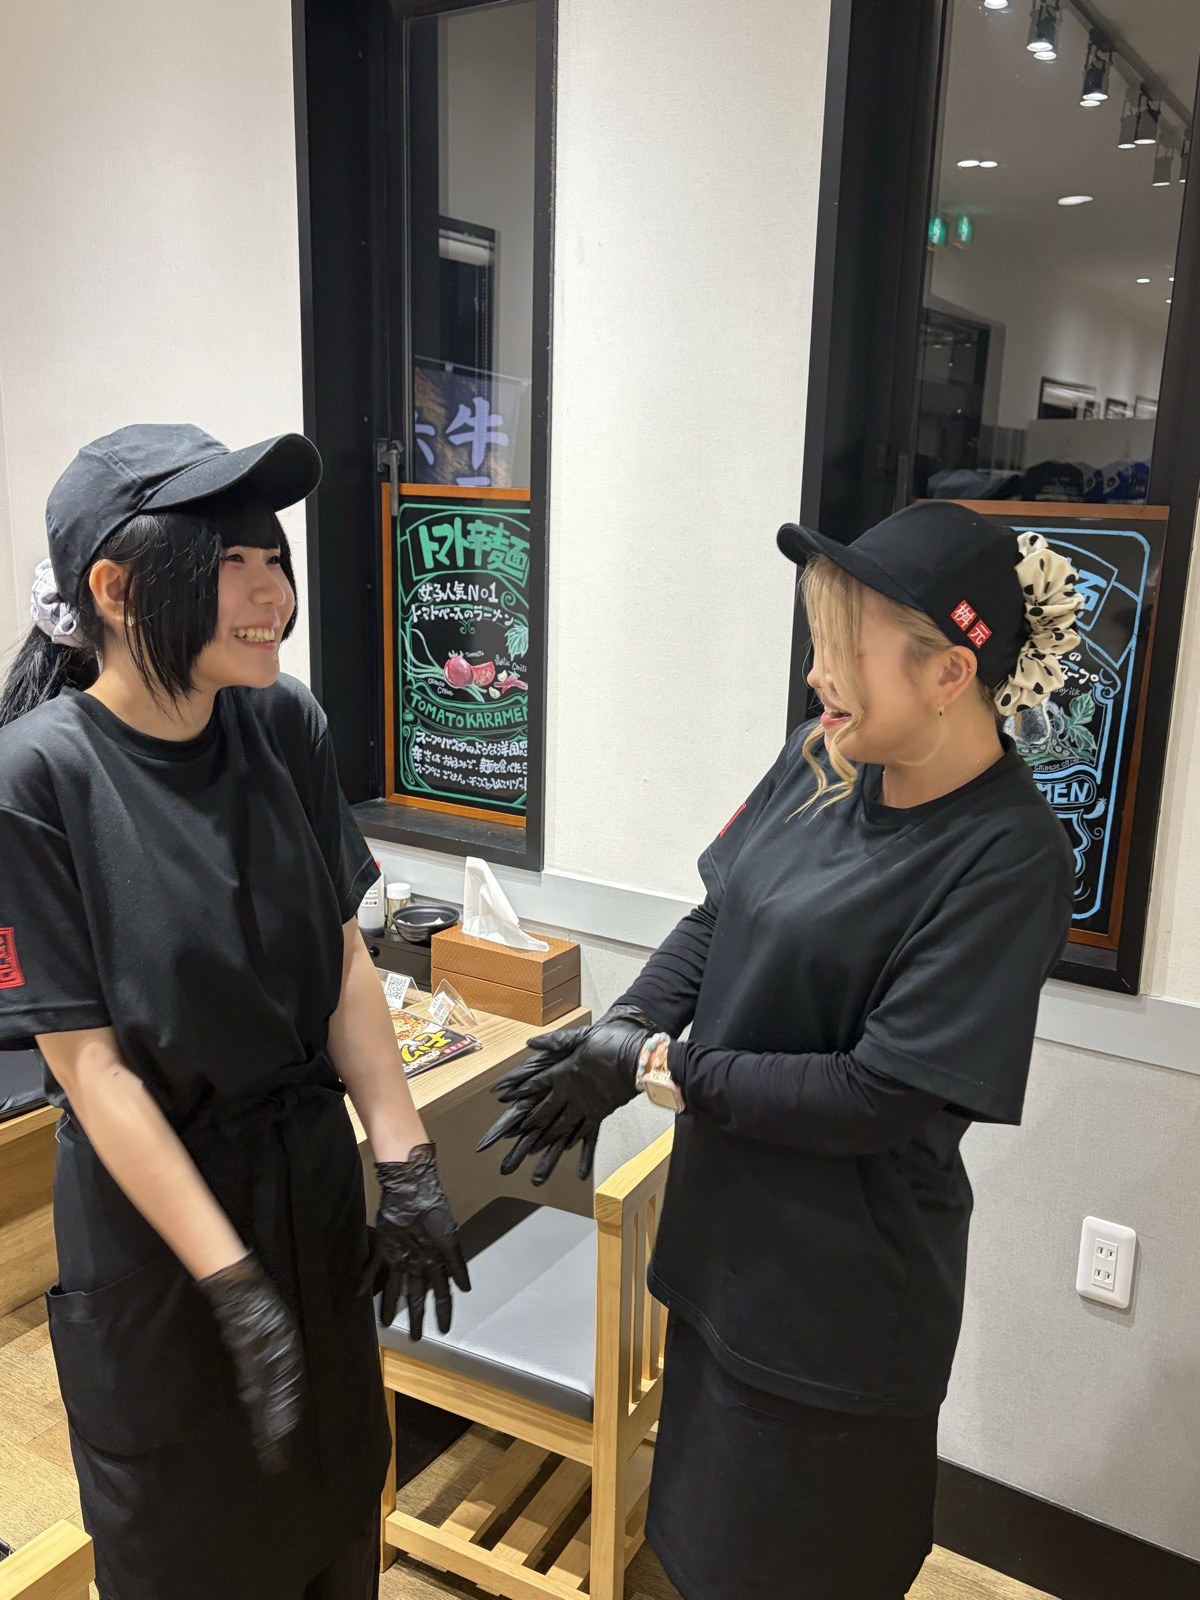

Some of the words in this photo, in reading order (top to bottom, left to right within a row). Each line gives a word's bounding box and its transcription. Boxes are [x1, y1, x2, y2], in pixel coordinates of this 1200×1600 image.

[445, 397, 510, 487] 牛
[418, 517, 530, 579] トマト辛麺
[411, 604, 515, 627] トマトベースのラーメン
